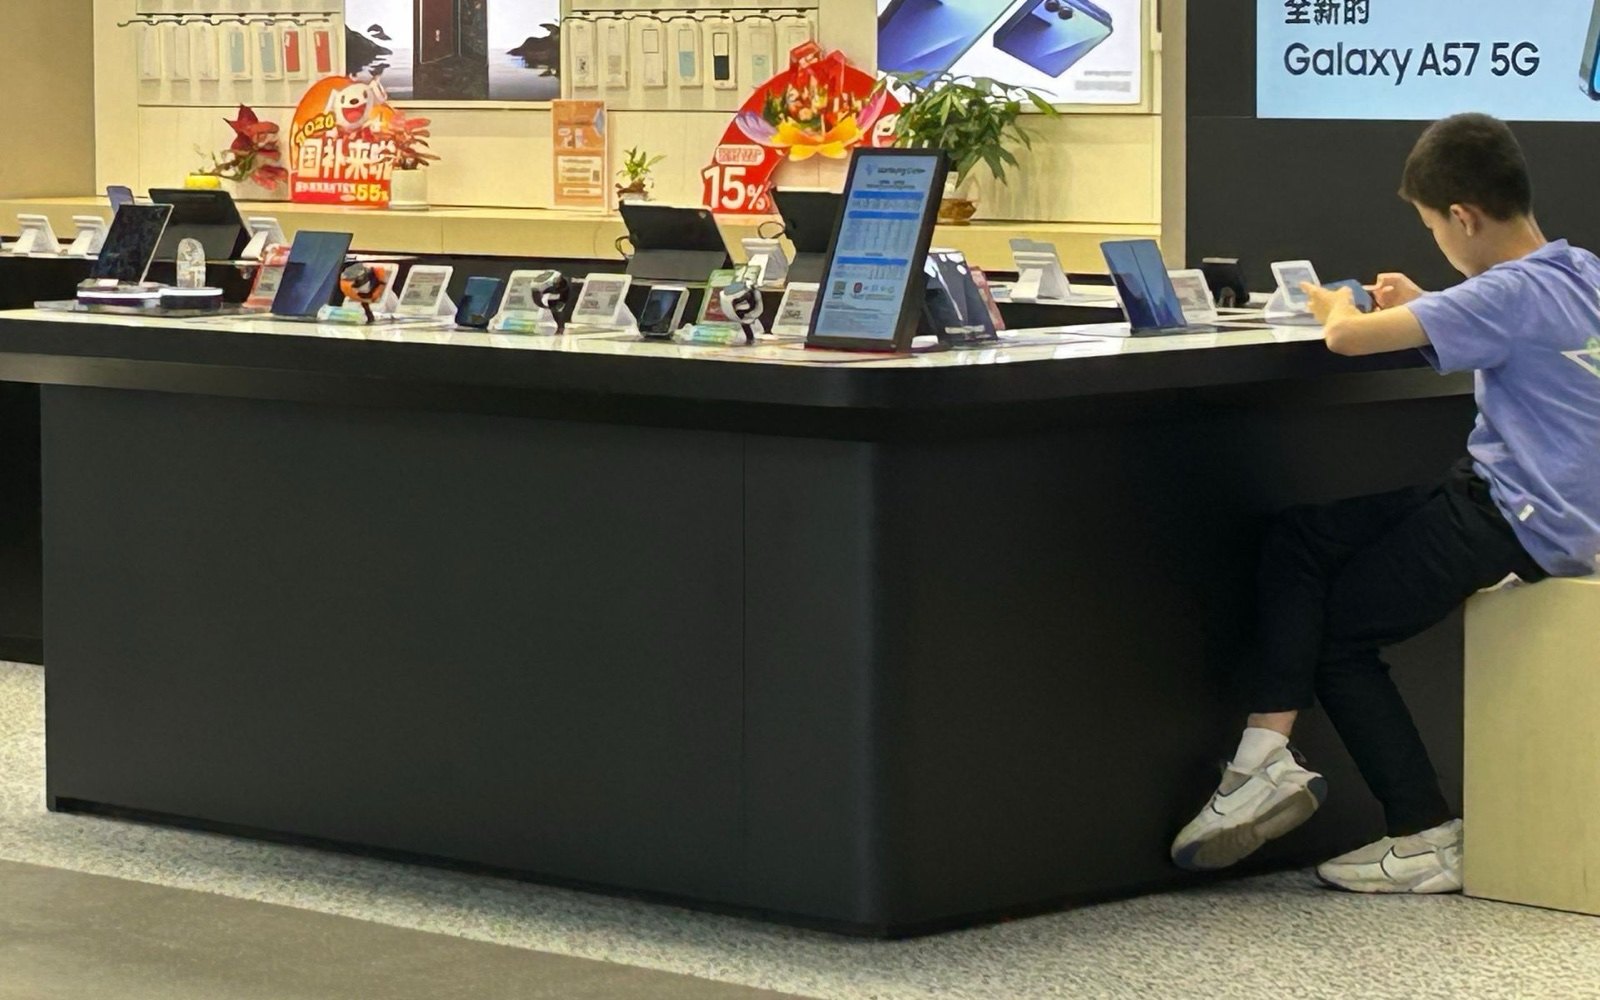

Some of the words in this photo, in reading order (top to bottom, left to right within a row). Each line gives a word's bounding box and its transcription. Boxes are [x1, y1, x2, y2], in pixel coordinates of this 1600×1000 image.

[1284, 0, 1369, 25] 全新的
[1284, 41, 1413, 86] Galaxy
[1417, 42, 1480, 77] A57
[1490, 42, 1540, 77] 5G
[704, 167, 766, 210] 15%
